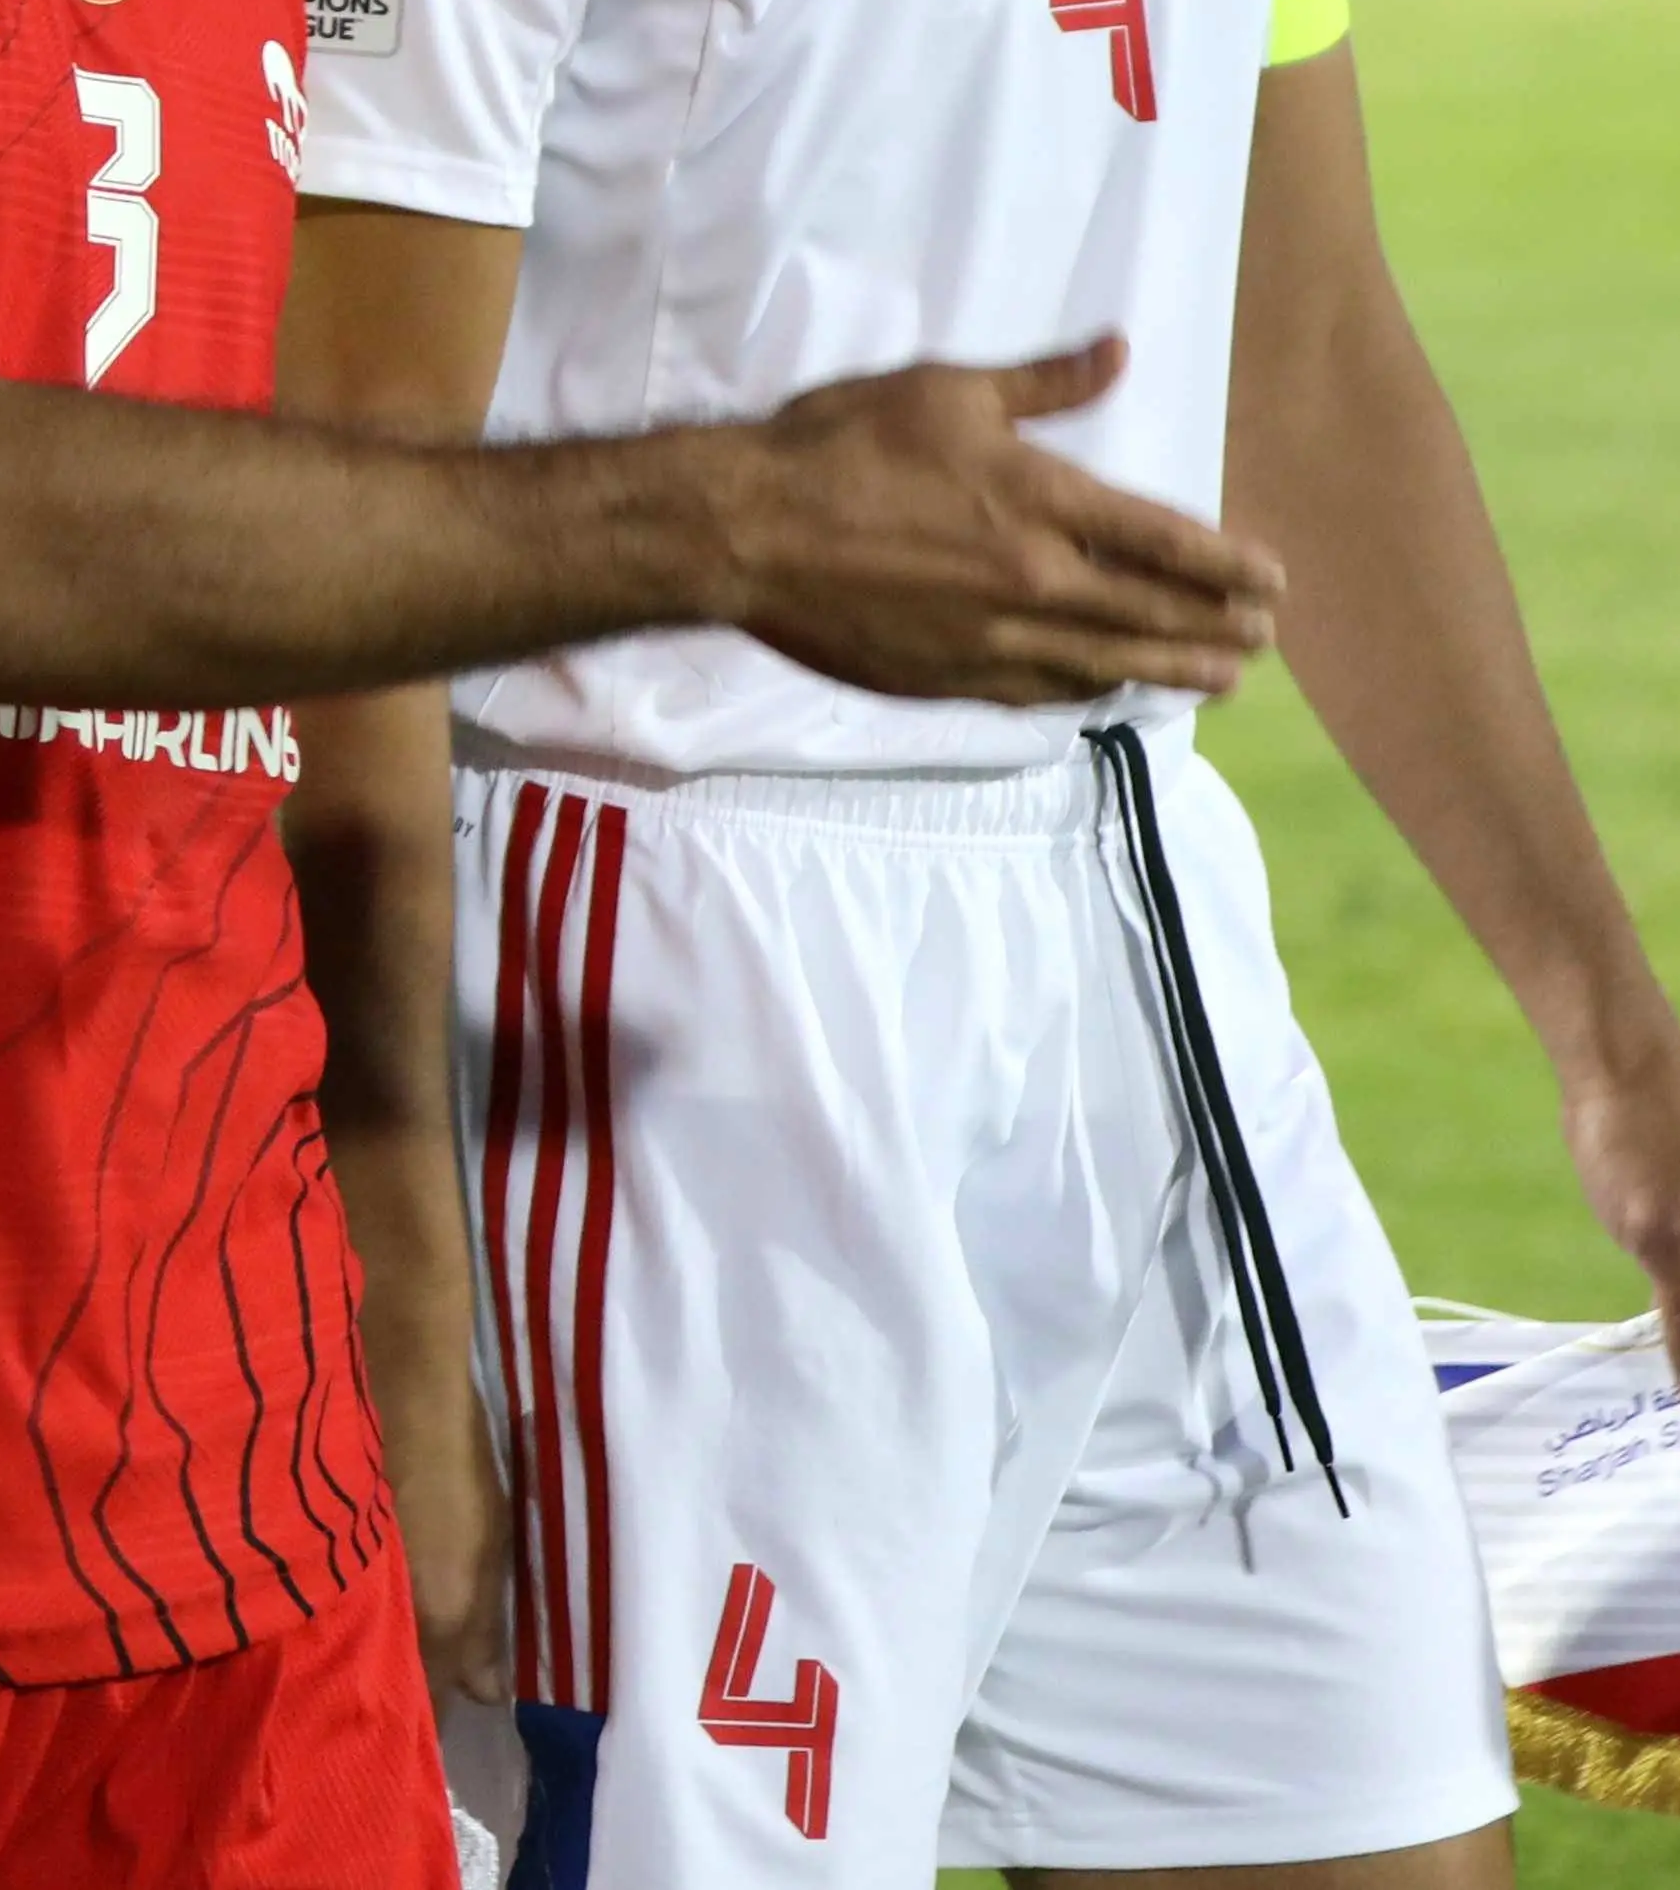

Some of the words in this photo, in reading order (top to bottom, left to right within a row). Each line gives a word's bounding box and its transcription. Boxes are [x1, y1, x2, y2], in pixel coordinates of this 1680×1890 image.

[71, 62, 161, 391] 3
[1537, 1435, 1651, 1498] Sharjah
[698, 1563, 839, 1839] 4
